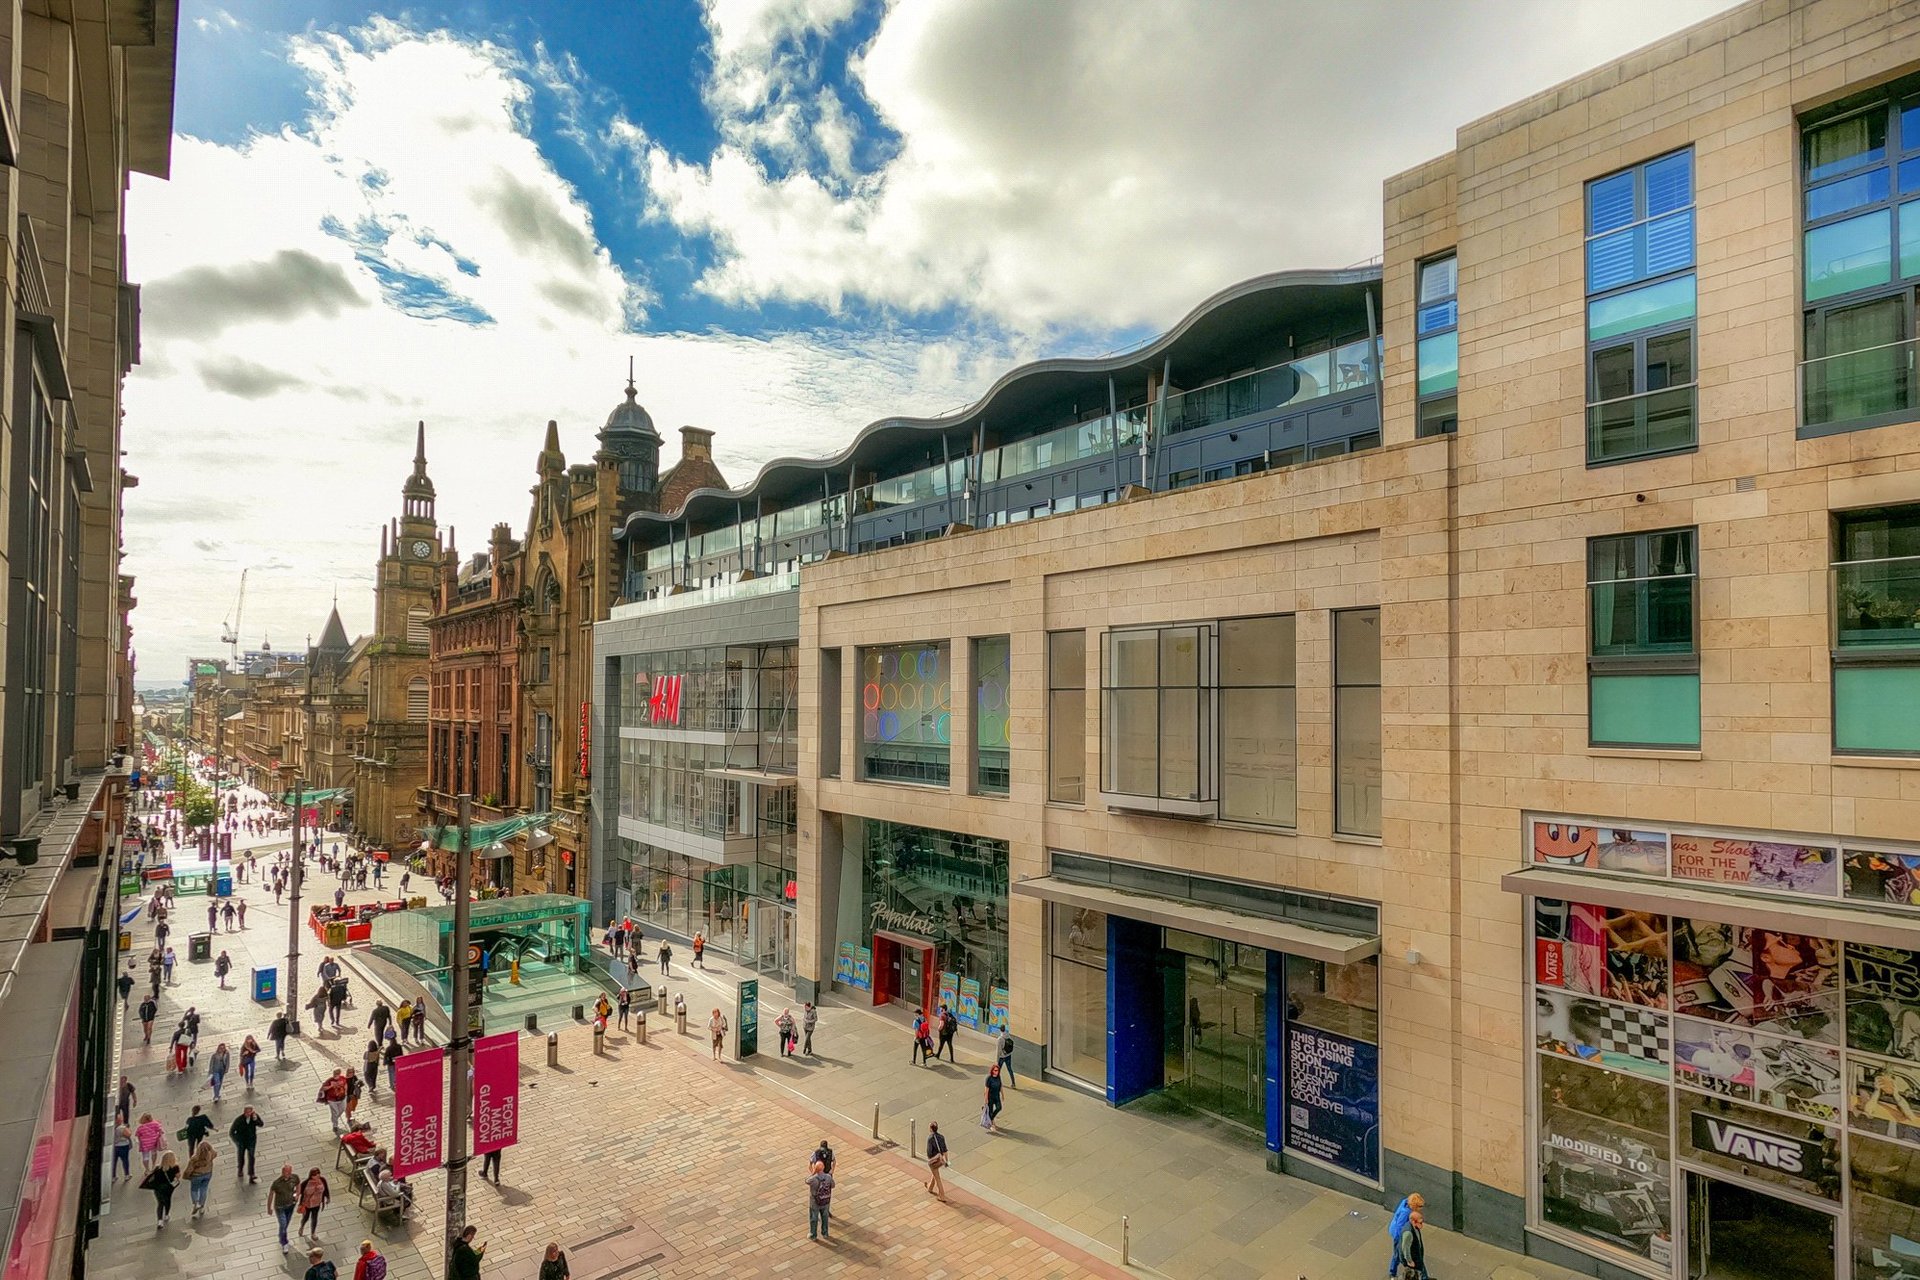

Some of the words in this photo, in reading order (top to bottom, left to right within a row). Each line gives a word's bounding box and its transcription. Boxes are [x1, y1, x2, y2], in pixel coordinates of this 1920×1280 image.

[1672, 865, 1715, 879] ENTIRE
[1679, 854, 1704, 866] FOR
[1710, 857, 1737, 869] THE
[1545, 950, 1558, 981] VANS
[1291, 1030, 1315, 1046] THIS
[1317, 1038, 1355, 1057] STORE
[1291, 1040, 1301, 1051] IS
[1303, 1044, 1353, 1067] CLOSING
[1291, 1059, 1311, 1073] BUT
[1313, 1065, 1339, 1083] THAT
[1290, 1088, 1344, 1115] GOODBYE!
[1291, 1079, 1320, 1096] MEAN
[479, 1084, 491, 1143] GLASGOW
[490, 1108, 502, 1142] MAKE
[501, 1096, 514, 1138] PEOPLE
[401, 1104, 413, 1166] GLASGOW
[412, 1128, 426, 1164] MAKE
[425, 1115, 438, 1161] PEOPLE
[1707, 1119, 1804, 1173] VANS
[1551, 1133, 1623, 1165] MODIFIED
[1627, 1157, 1648, 1173] TO
